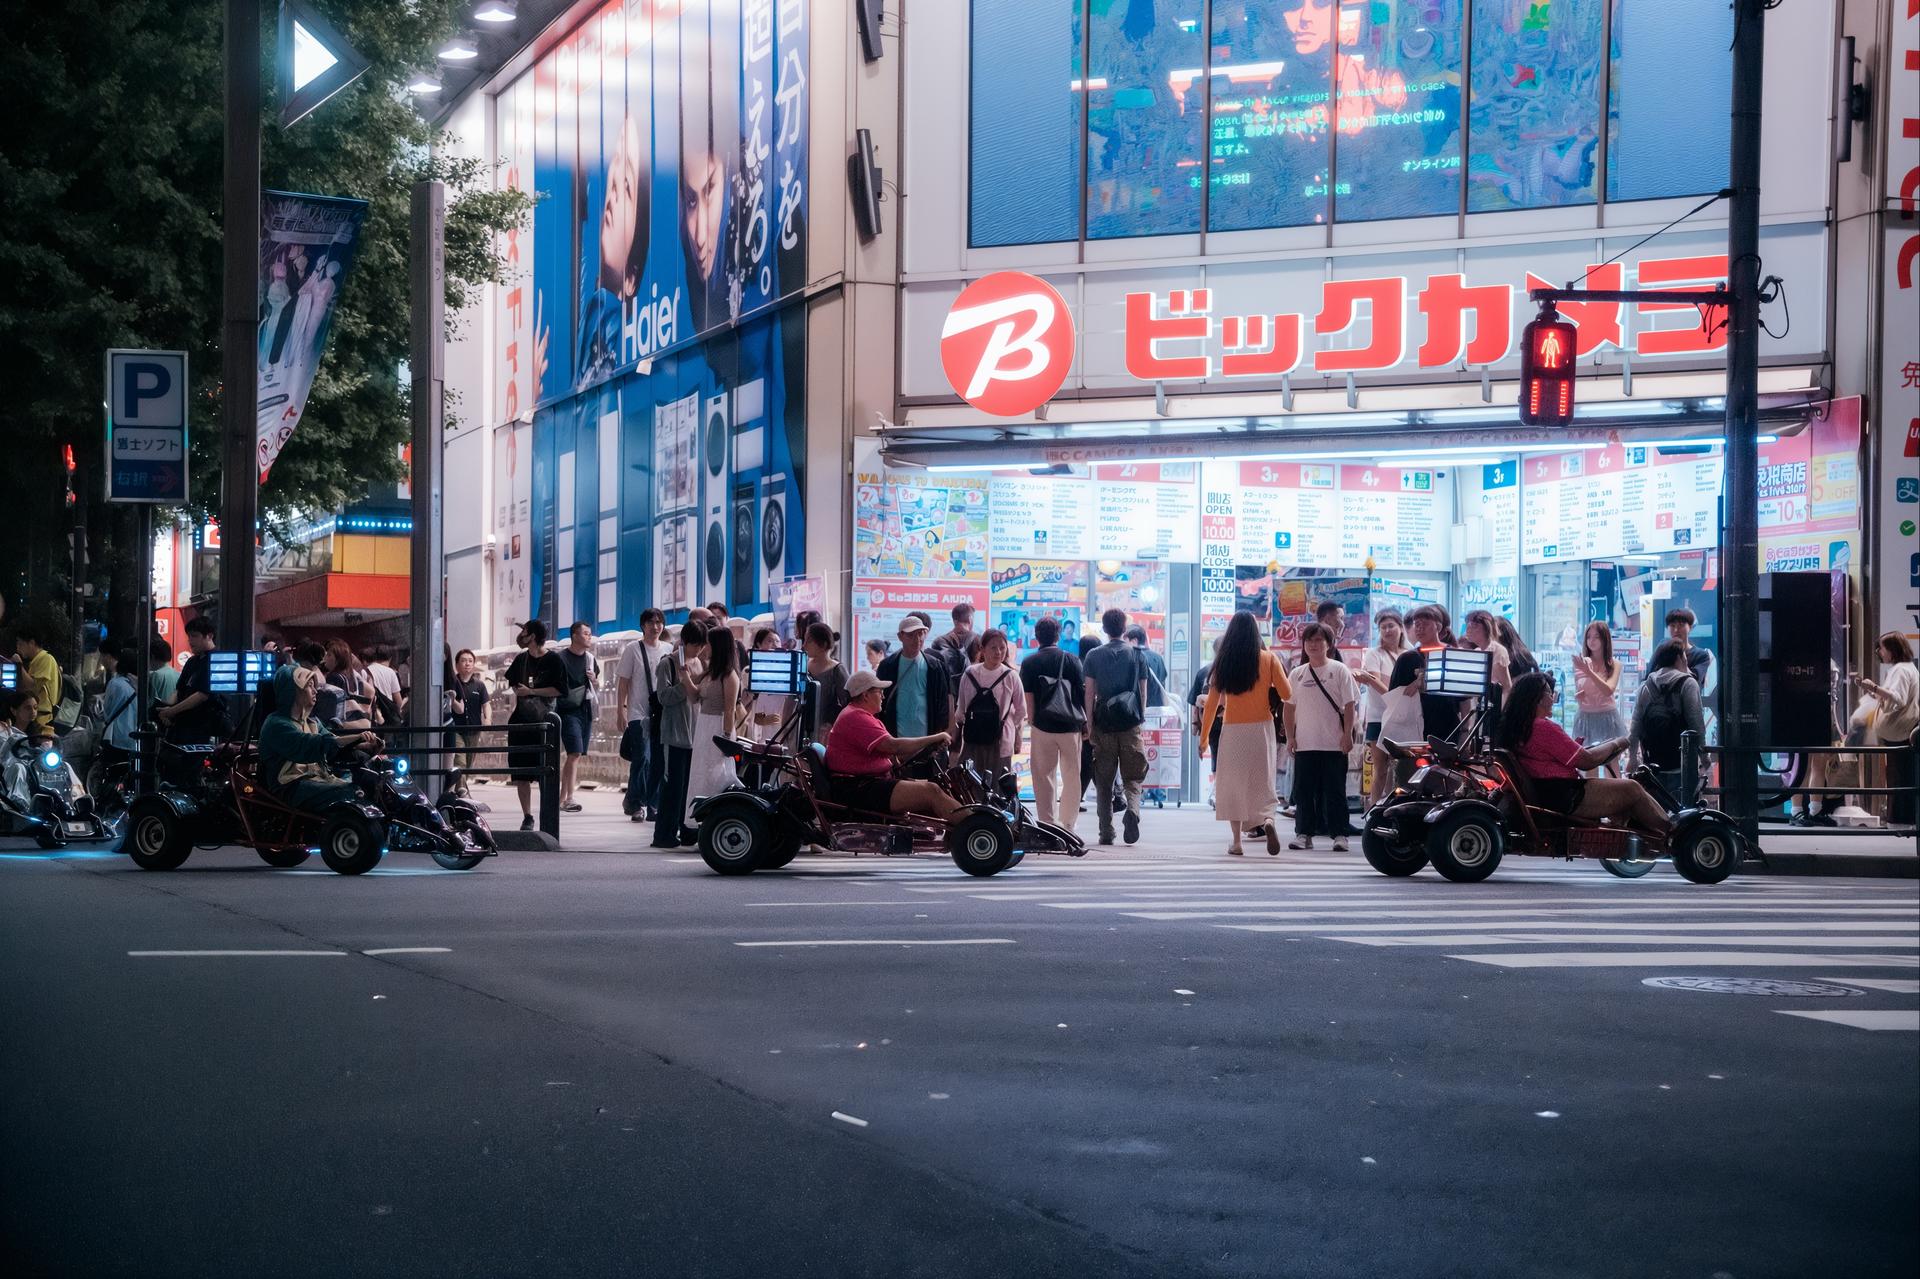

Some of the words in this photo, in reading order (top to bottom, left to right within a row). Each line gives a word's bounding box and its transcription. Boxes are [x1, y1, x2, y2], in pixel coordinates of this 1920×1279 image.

[621, 283, 680, 364] Haier
[124, 363, 171, 418] P
[1493, 467, 1504, 485] 3F
[1205, 504, 1233, 515] OPEN
[1211, 516, 1226, 526] AM
[1203, 557, 1234, 567] CLOSE
[1211, 569, 1225, 578] PM
[1203, 579, 1234, 592] 10:00
